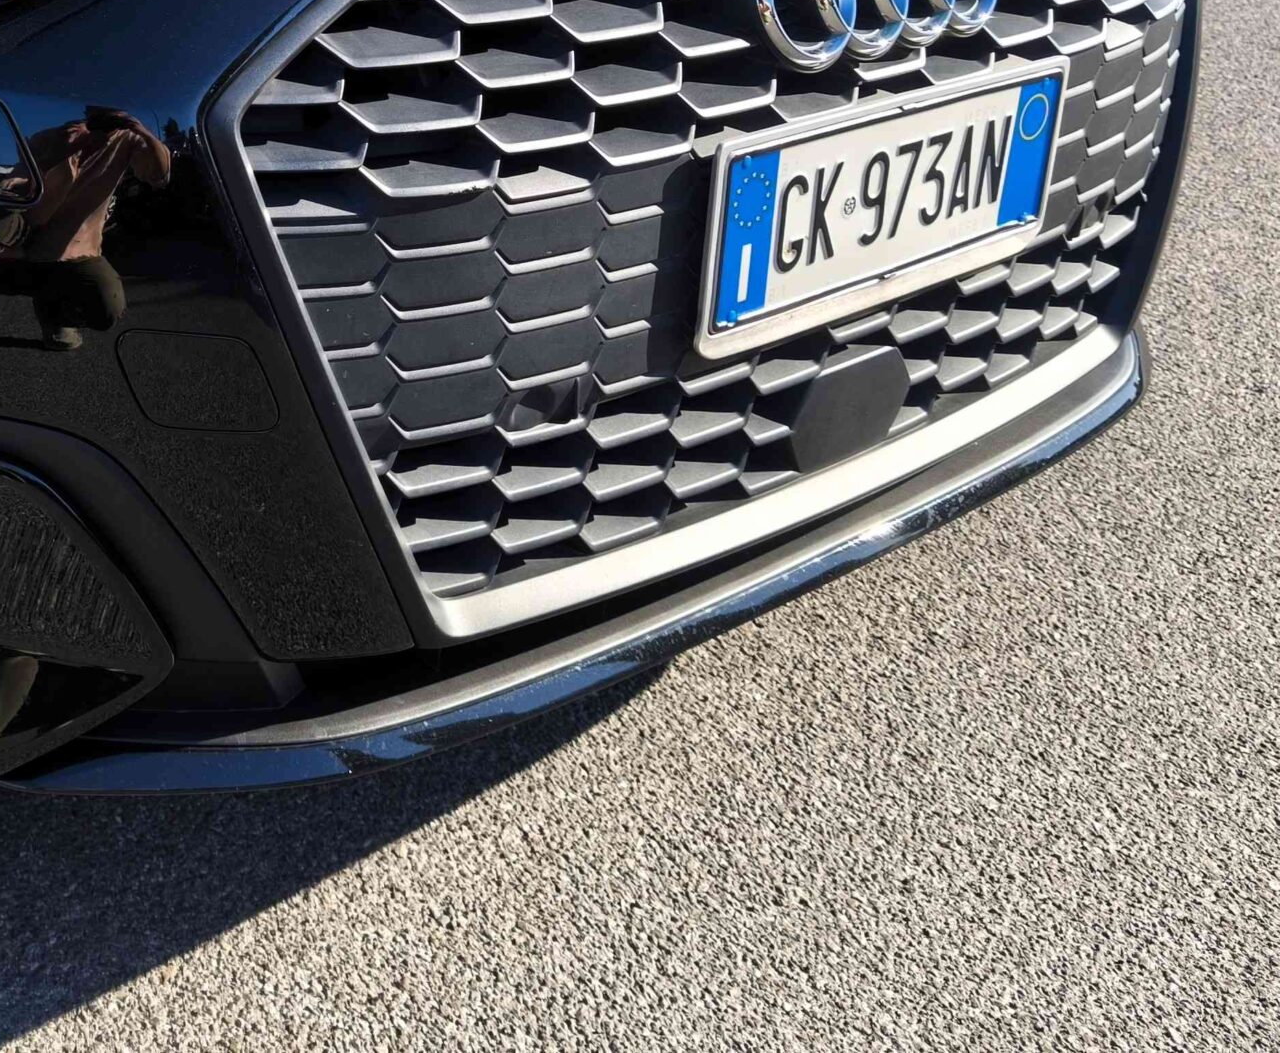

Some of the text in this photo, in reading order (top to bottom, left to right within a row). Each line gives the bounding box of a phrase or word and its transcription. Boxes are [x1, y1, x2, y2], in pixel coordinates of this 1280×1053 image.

[775, 115, 1012, 274] GK 973AN
[737, 243, 752, 303] I
